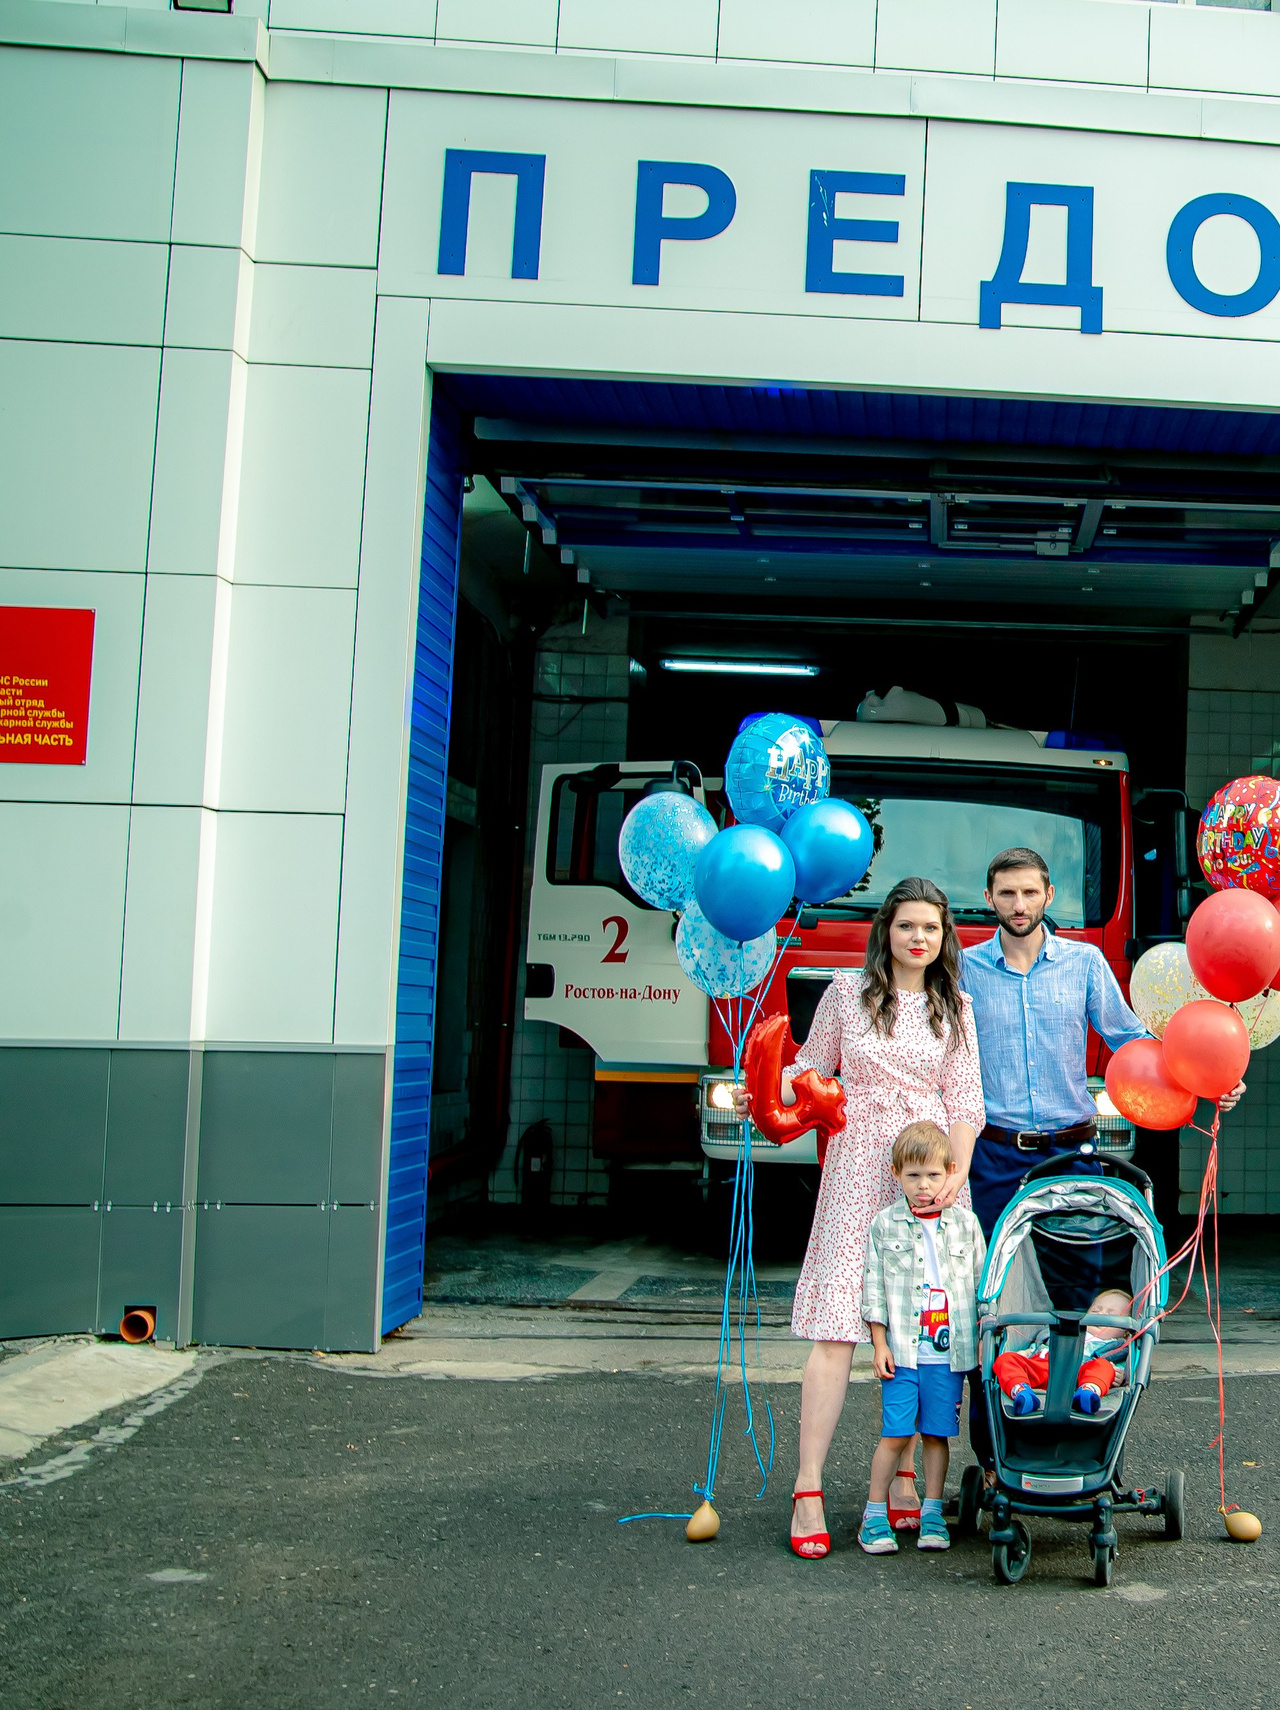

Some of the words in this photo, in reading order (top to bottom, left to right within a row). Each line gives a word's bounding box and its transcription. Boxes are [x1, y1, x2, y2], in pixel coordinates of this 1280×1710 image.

[12, 676, 49, 686] России
[15, 698, 45, 708] отряд
[27, 708, 66, 719] службы
[35, 719, 74, 730] службы
[34, 733, 74, 746] ЧАСТЬ
[778, 783, 820, 806] Birthd
[1203, 803, 1257, 827] HAPPY
[537, 933, 556, 941] TGM
[599, 915, 630, 964] 2
[564, 983, 681, 1004] Ростов-на-Дону
